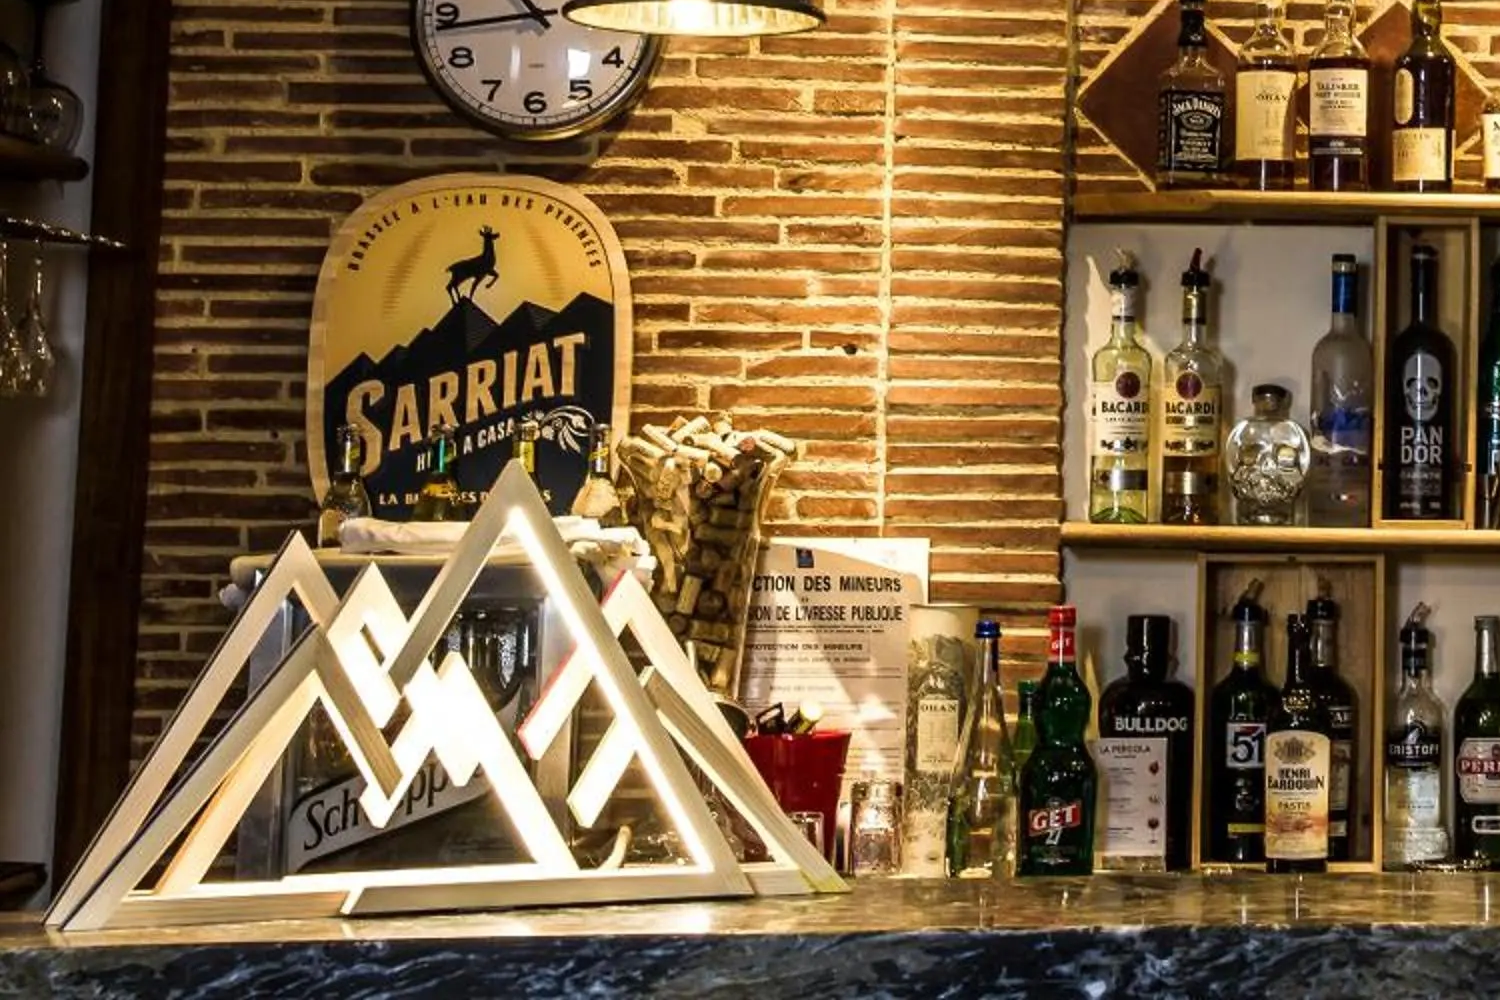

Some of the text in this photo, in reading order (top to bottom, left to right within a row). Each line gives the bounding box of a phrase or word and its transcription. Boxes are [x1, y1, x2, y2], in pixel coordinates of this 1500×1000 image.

[435, 2, 460, 30] 9
[448, 47, 475, 69] 8
[602, 46, 624, 68] 4
[481, 79, 502, 101] 7
[568, 80, 593, 100] 5
[523, 91, 547, 114] 6
[345, 332, 586, 477] SARRIAT
[1101, 401, 1150, 413] BACARD
[463, 435, 473, 454] A
[1401, 426, 1443, 445] PAN
[1401, 445, 1443, 465] DOR
[803, 575, 831, 592] DES
[839, 575, 901, 592] MINEURS
[851, 605, 903, 621] PUBLIQUE
[1115, 717, 1188, 731] BULLDOG
[304, 762, 482, 850] Schpp
[1033, 804, 1077, 830] GET
